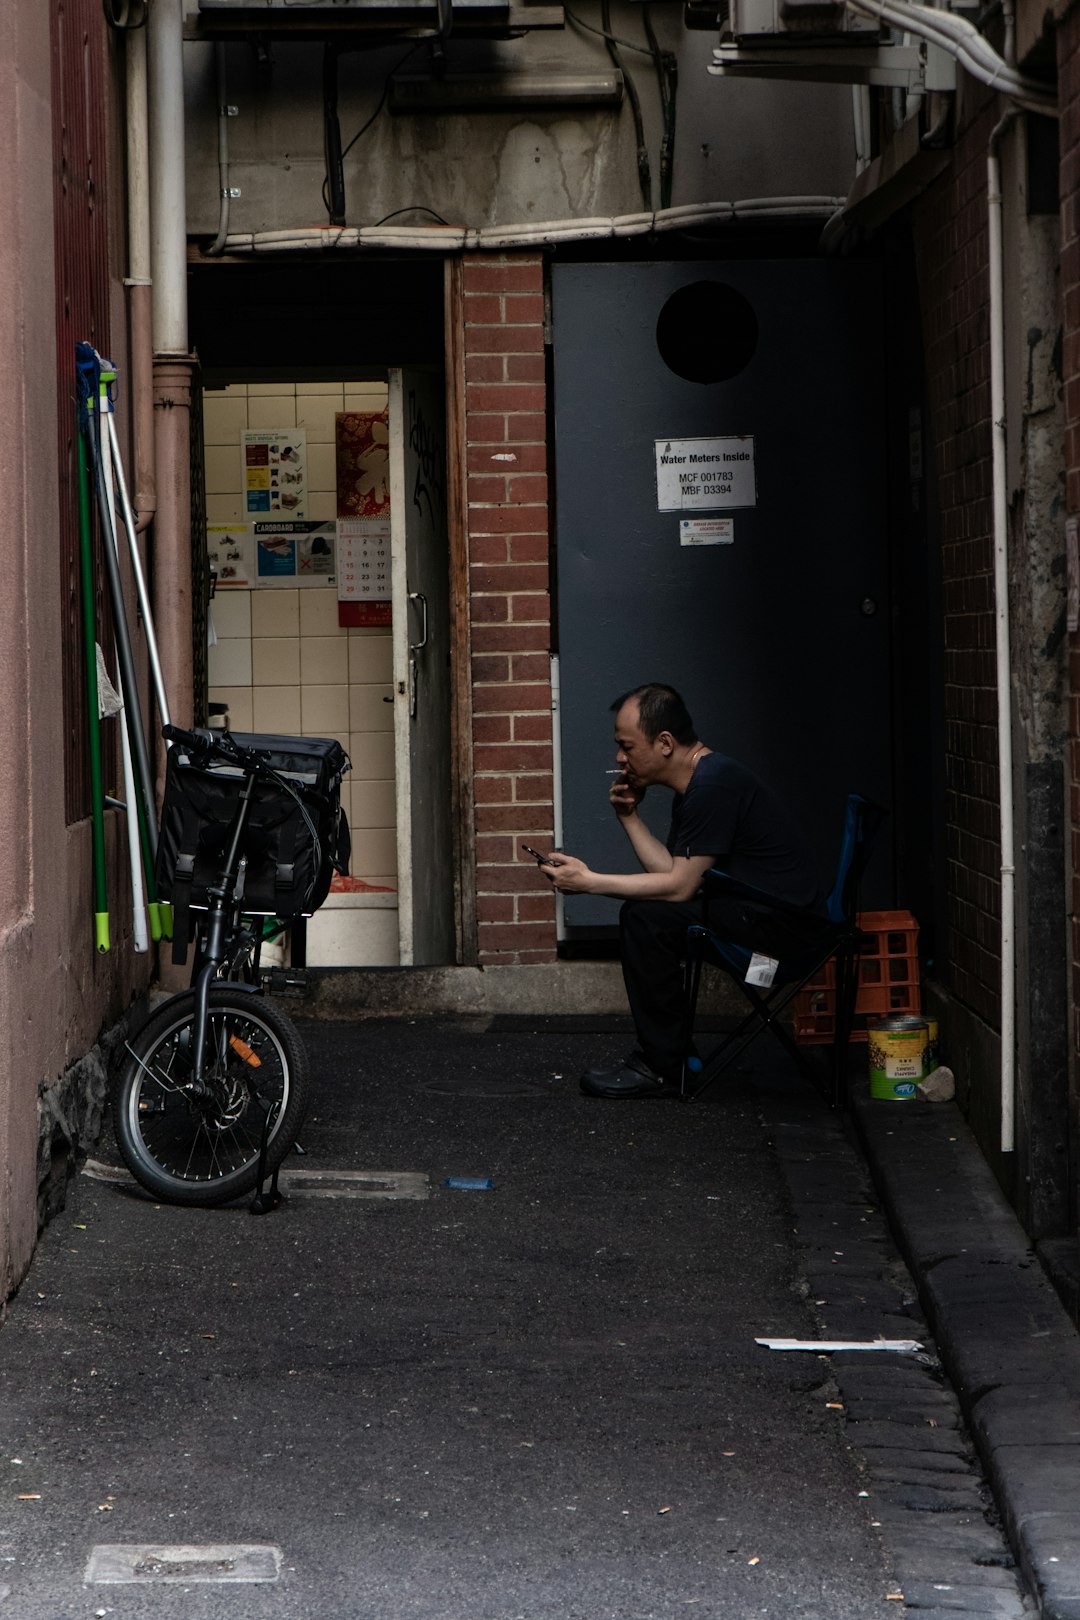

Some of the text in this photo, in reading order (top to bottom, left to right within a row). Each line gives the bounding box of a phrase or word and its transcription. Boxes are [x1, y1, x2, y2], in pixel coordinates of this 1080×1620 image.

[660, 452, 750, 464] Water Meters Inside
[679, 472, 734, 482] MCF 001783
[682, 484, 732, 495] MBF D3394
[256, 524, 294, 532] CARDBOARD
